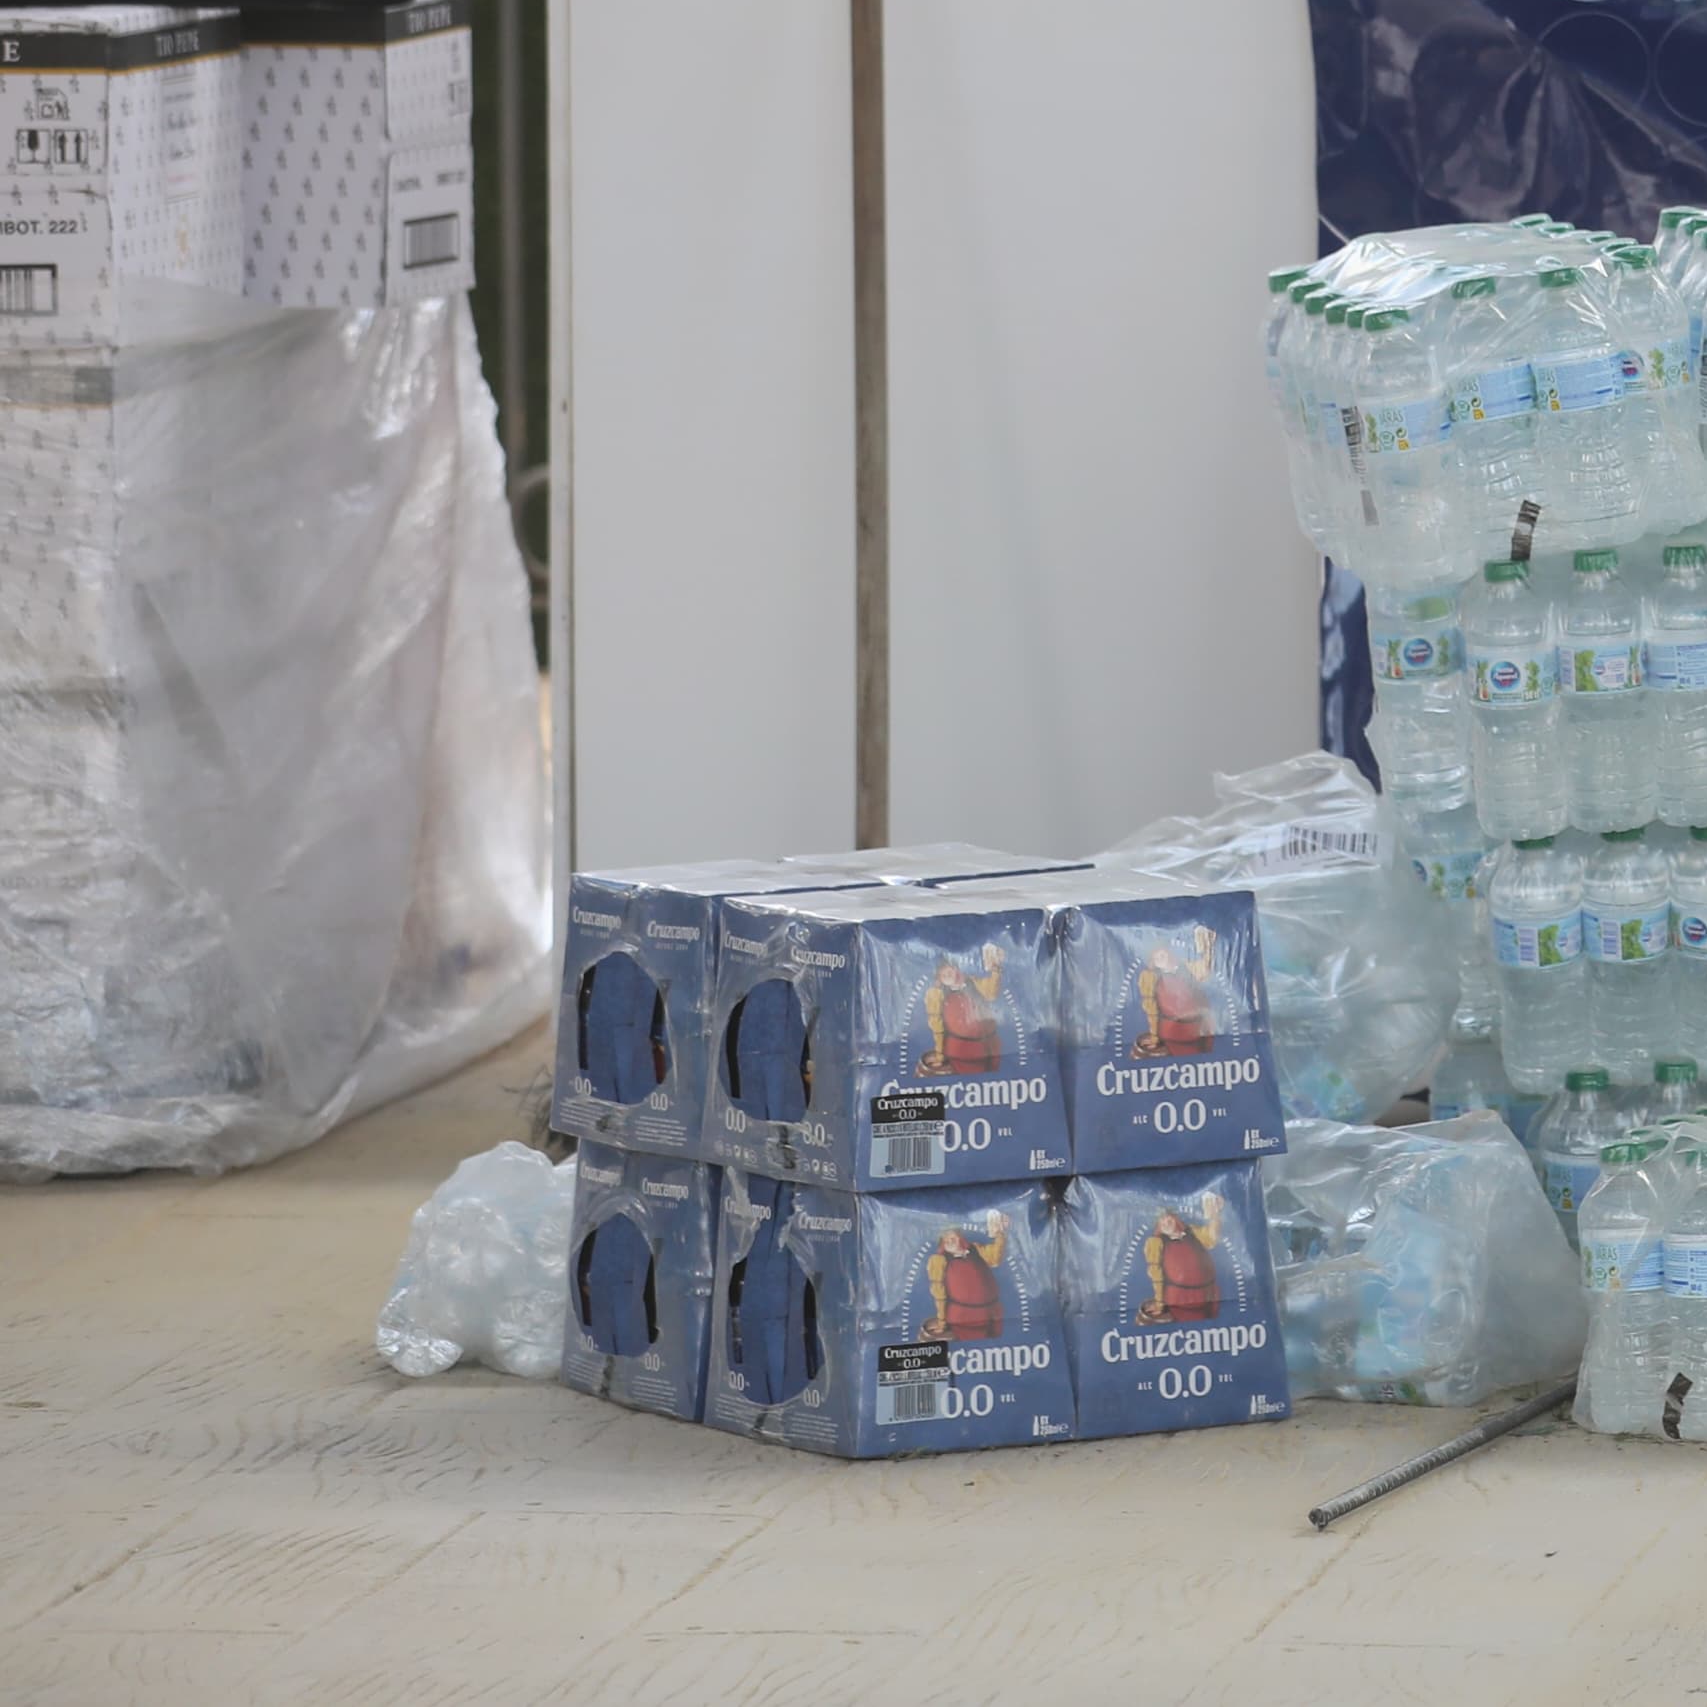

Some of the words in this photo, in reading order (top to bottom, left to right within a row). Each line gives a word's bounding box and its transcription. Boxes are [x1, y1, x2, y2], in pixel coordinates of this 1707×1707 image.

[49, 220, 79, 235] 222
[573, 906, 623, 931] Cruzcampo
[647, 919, 701, 943] Cruzcampo
[724, 929, 769, 958] Cruzcampo
[790, 944, 847, 970] Cruzcampo
[1097, 1056, 1260, 1097] Cruzcampo
[650, 1093, 669, 1111] 0.0
[877, 1097, 938, 1110] Cruzcampo
[899, 1109, 917, 1120] 0.0
[1153, 1098, 1207, 1134] 0.0
[937, 1117, 992, 1153] 0.0
[642, 1176, 690, 1201] Cruzcampo
[800, 1212, 852, 1234] Cruzcampo
[884, 1346, 942, 1360] Cruzcampo
[1101, 1322, 1267, 1363] Cruzcampo
[903, 1357, 921, 1369] 0.0
[1158, 1364, 1213, 1400] 0.0
[939, 1384, 995, 1419] 0.0
